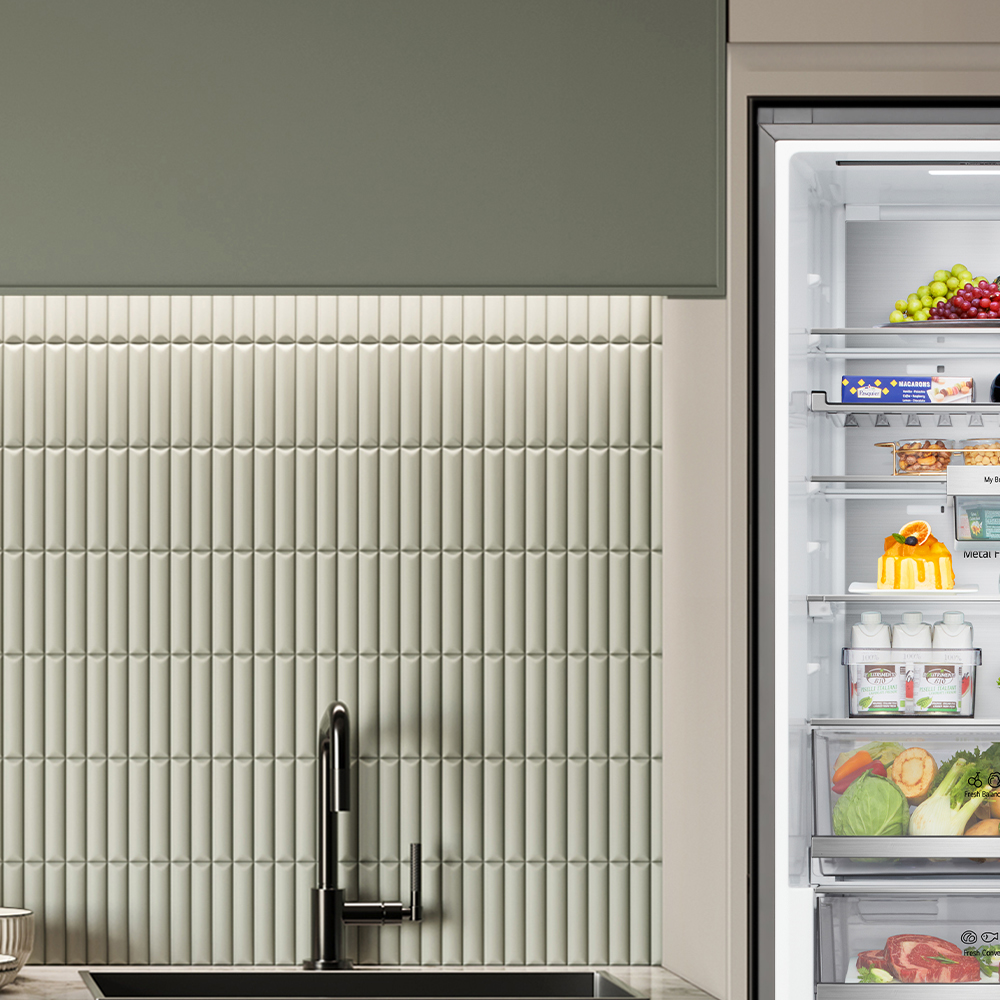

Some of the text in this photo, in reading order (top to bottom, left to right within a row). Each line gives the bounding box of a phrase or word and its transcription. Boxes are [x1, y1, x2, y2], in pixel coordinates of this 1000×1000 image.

[984, 476, 993, 484] My
[964, 790, 980, 798] Fresh
[963, 949, 980, 957] Fresh
